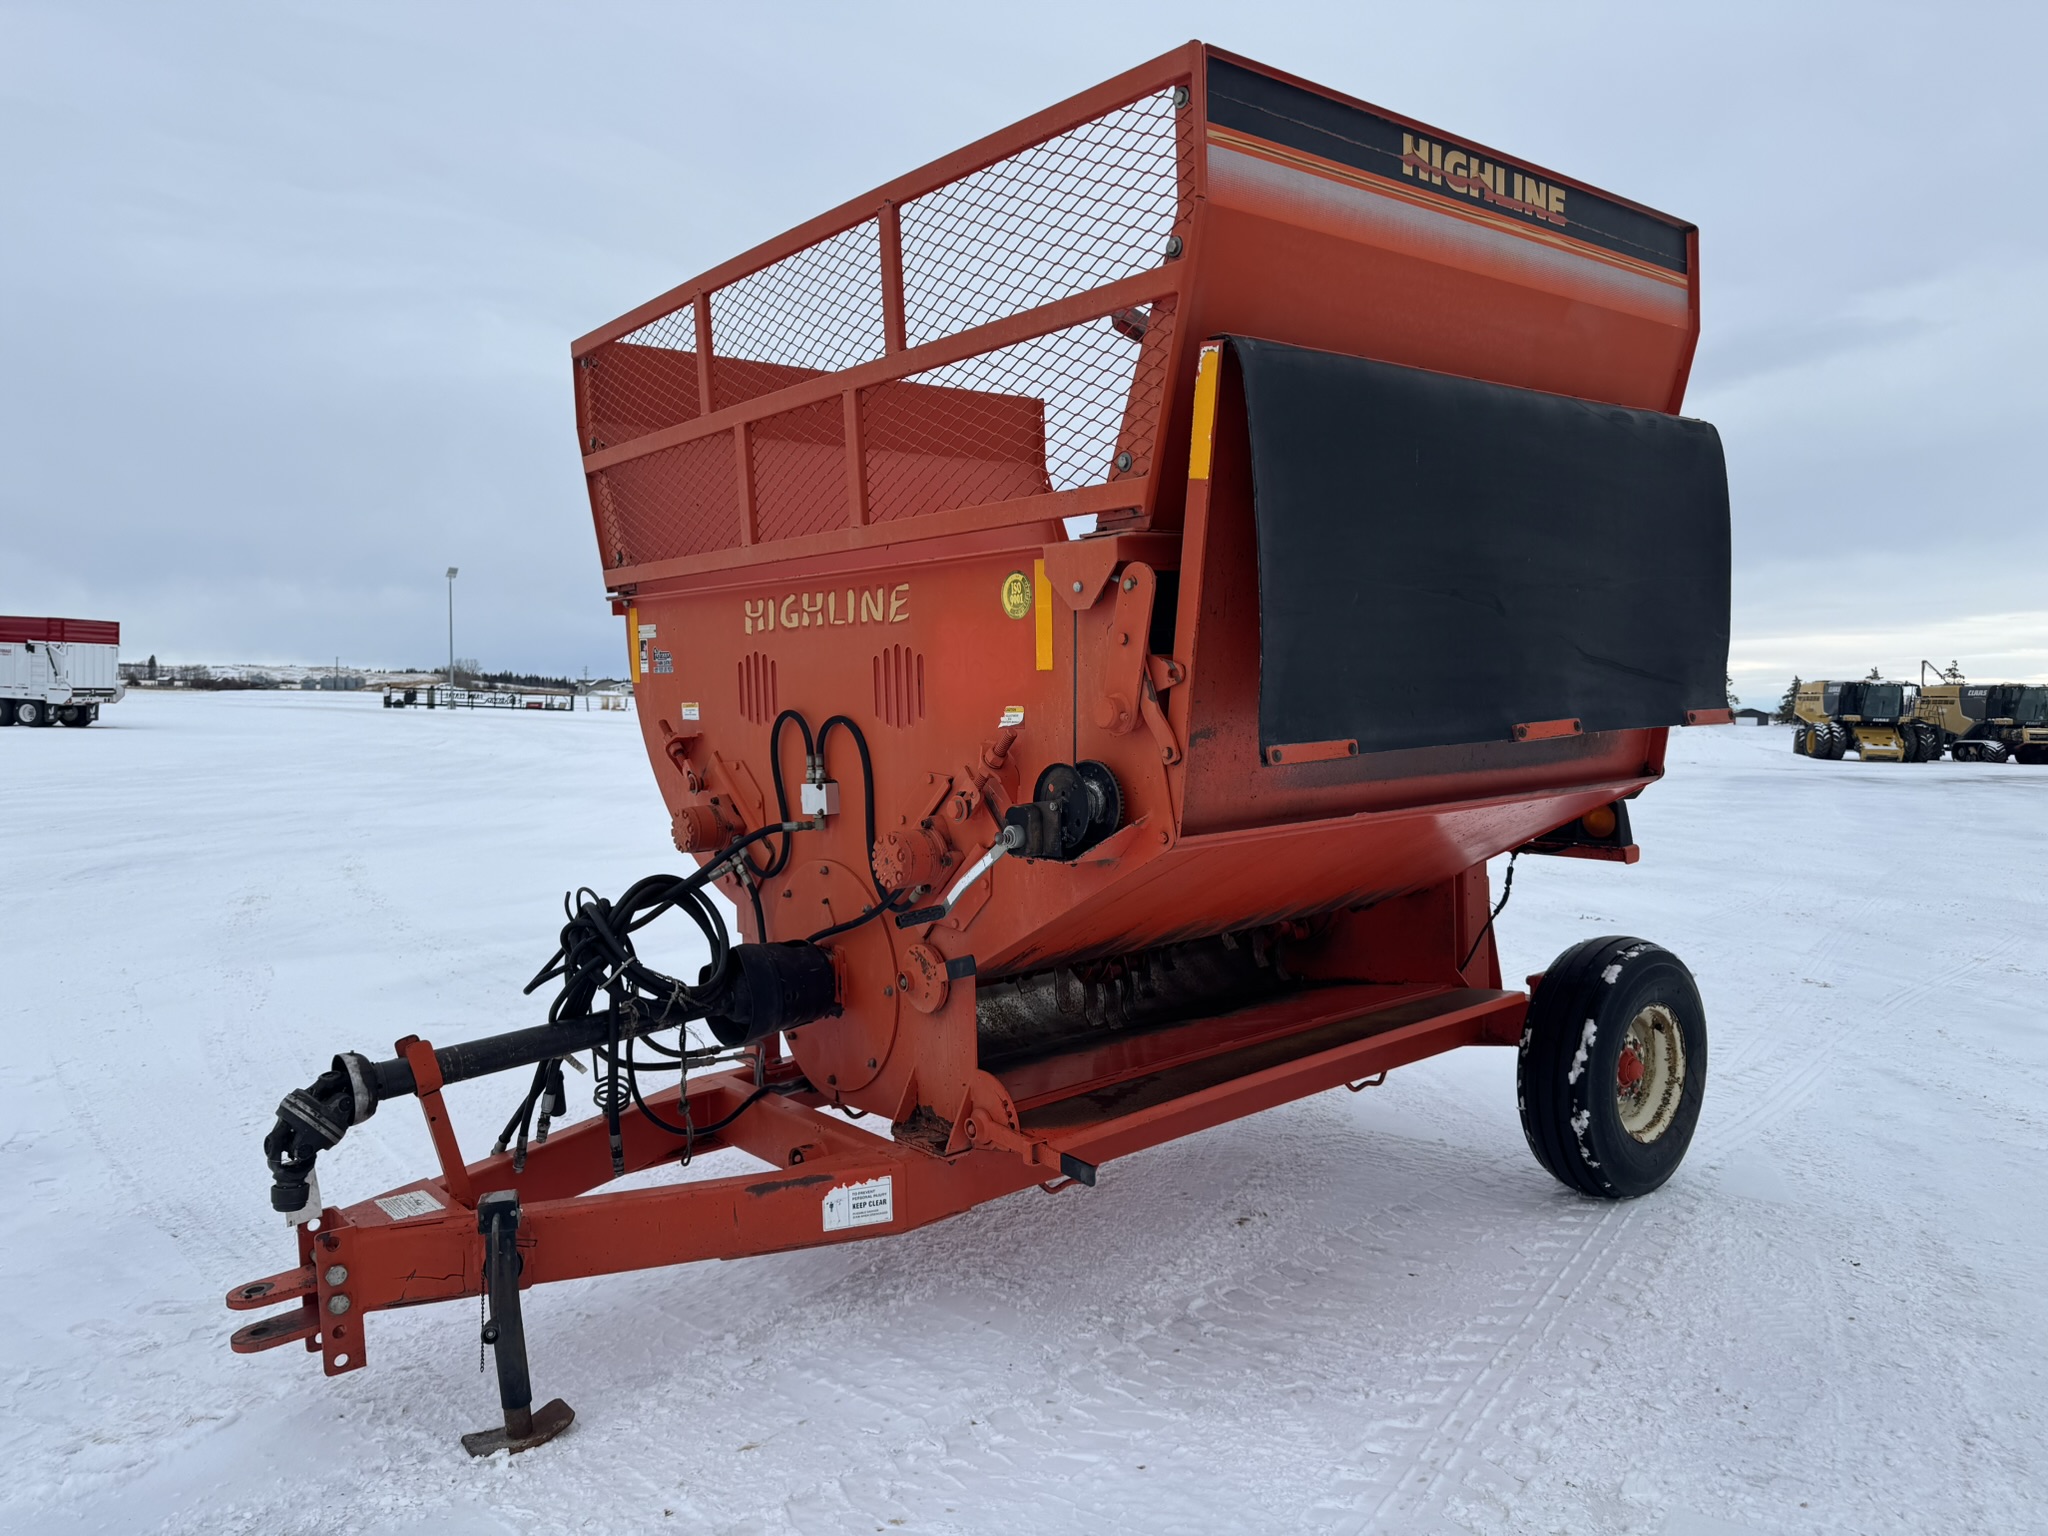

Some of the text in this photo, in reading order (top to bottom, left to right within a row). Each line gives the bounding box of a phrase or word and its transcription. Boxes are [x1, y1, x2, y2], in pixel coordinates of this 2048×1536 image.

[1402, 132, 1567, 227] HIGHLINE
[1011, 582, 1022, 594] ISO
[744, 583, 910, 635] HIGHLINE
[852, 1198, 887, 1210] KEEP CLEAR
